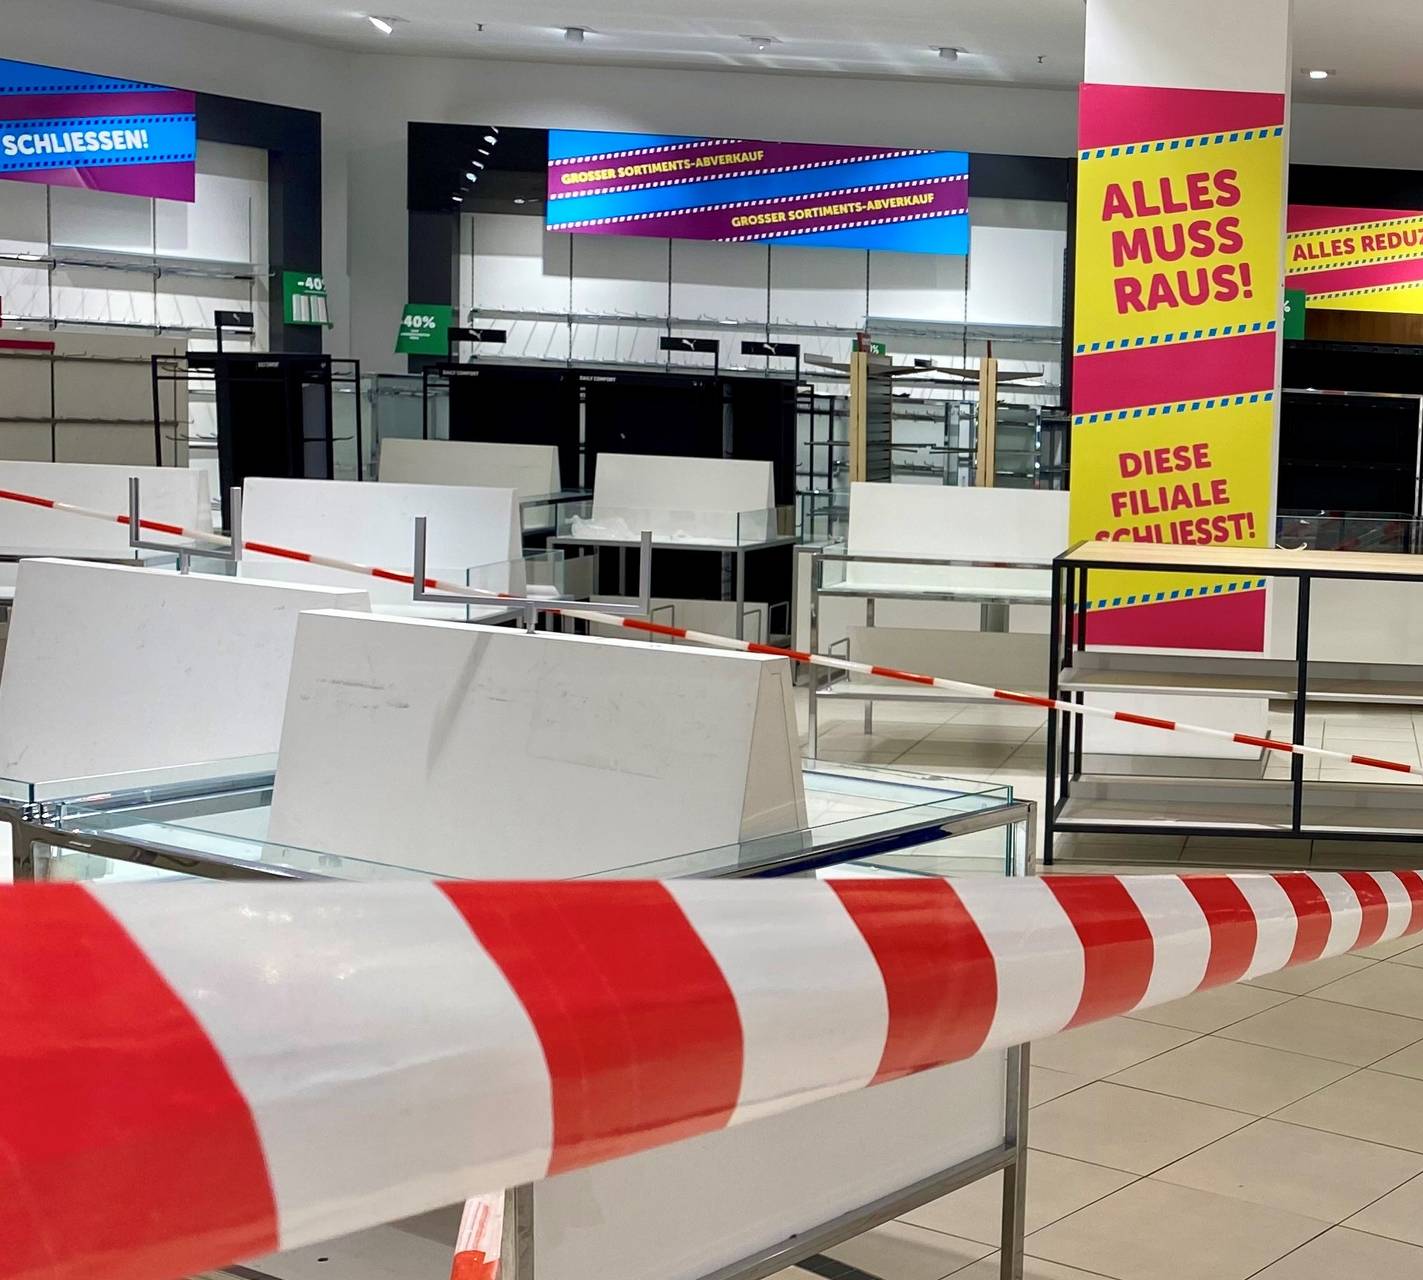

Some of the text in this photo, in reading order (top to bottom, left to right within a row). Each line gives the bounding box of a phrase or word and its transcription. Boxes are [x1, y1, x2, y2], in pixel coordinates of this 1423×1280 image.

[2, 129, 149, 156] SCHLIESSEN!
[560, 150, 765, 185] GROSSER SORTIMENTS-ABVERKAUF
[731, 193, 935, 228] GROSSER SORTIMENTS-ABVERKAUF
[1101, 168, 1242, 222] ALLES
[1111, 216, 1244, 268] MUSS
[1292, 237, 1356, 262] ALLES
[1113, 262, 1254, 315] RAUS!
[402, 314, 436, 329] 40%
[1118, 442, 1212, 479] DIESE
[1110, 478, 1231, 518] FILIALE
